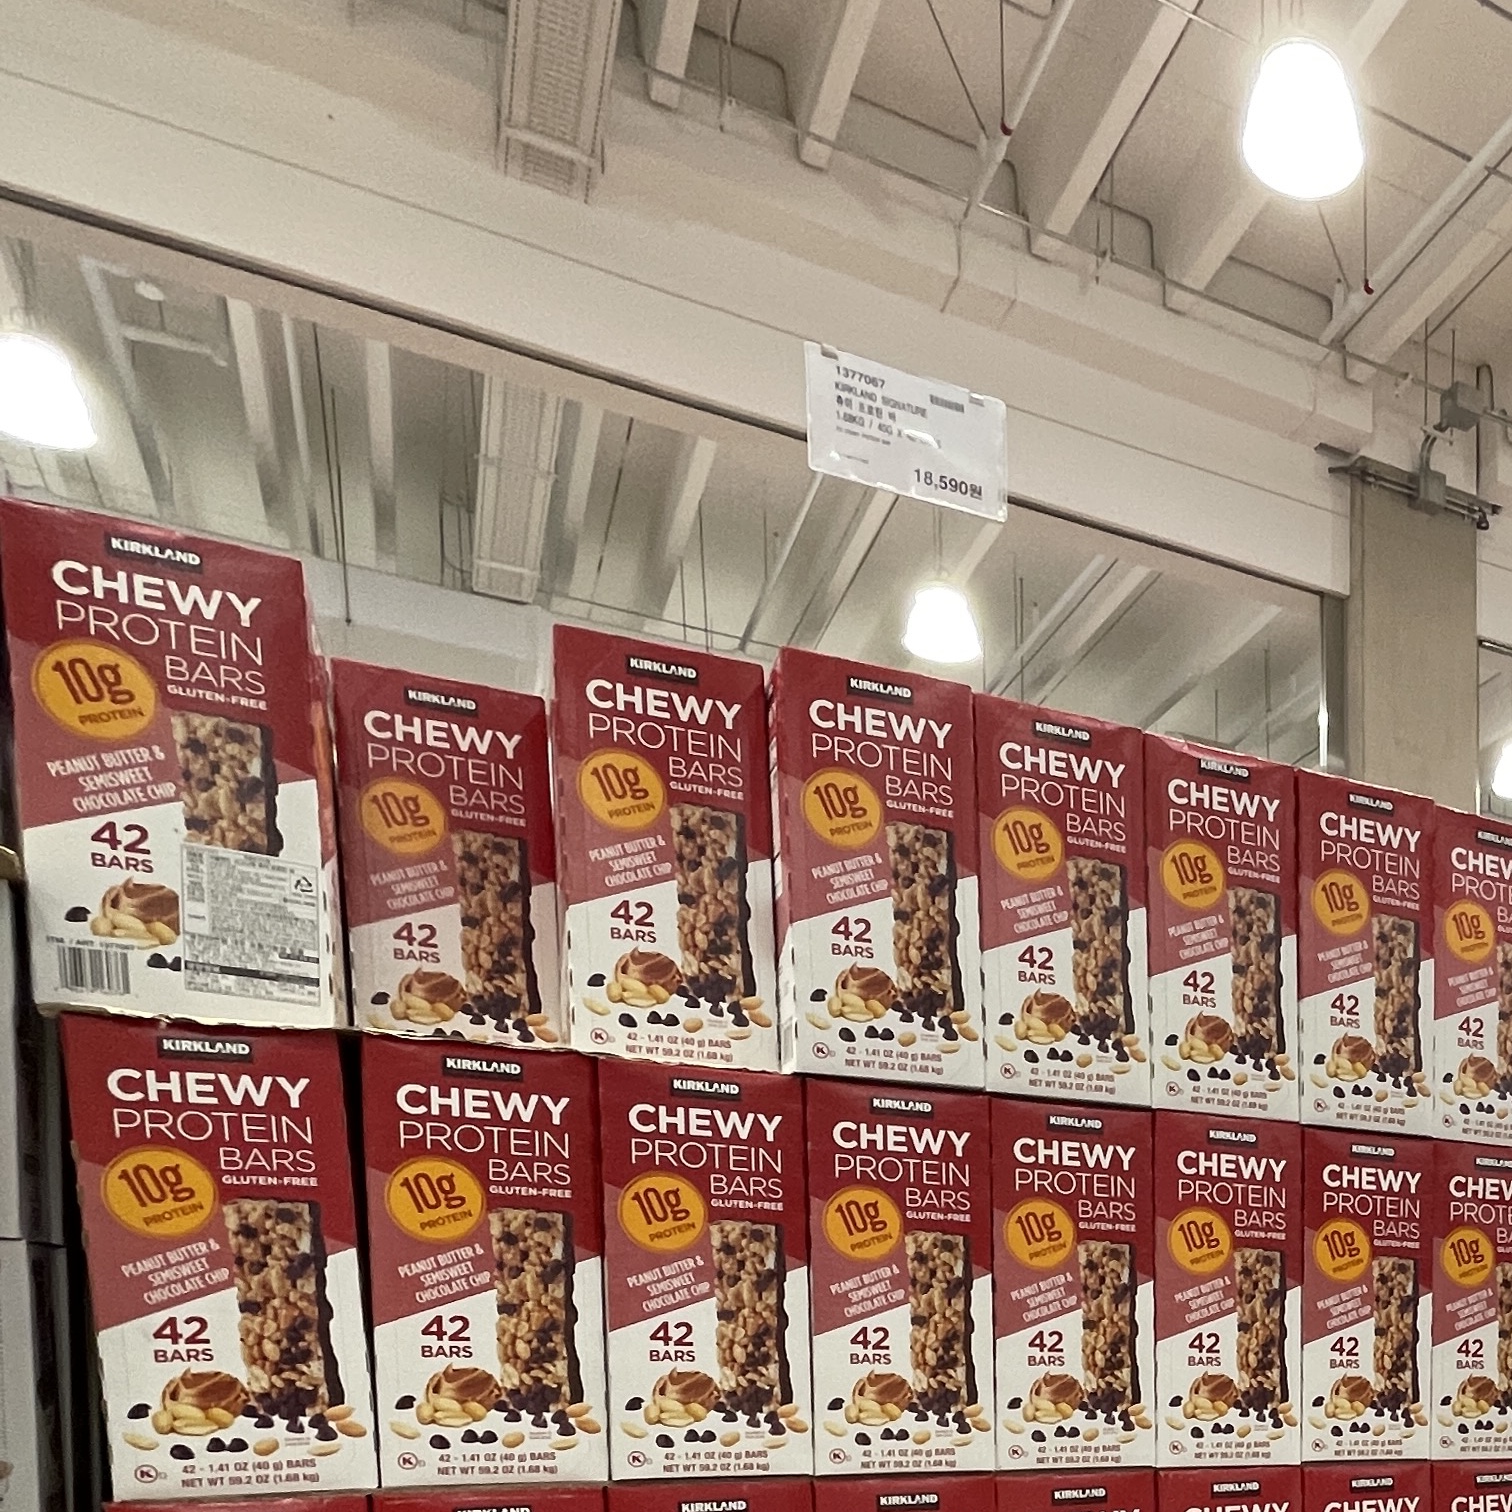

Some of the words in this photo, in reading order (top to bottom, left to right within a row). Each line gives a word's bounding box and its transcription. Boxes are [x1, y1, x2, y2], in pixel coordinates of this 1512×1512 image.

[835, 382, 877, 402] KIRKLAND
[881, 396, 928, 418] SIGNATURE
[914, 468, 983, 501] 18,590원
[110, 538, 200, 565] KIRKLAND
[51, 561, 262, 627] CHEWY
[56, 600, 264, 666] PROTEIN
[166, 656, 267, 695] BARS
[630, 658, 696, 677] KIRKLAND
[61, 662, 139, 705] 10g
[168, 685, 269, 710] GLUTEN-FREE
[84, 709, 148, 724] PROTEIN
[587, 679, 741, 729] CHEWY
[590, 713, 740, 762] PROTEIN
[592, 765, 648, 801] 10g
[669, 757, 742, 787] BARS
[91, 821, 151, 855] 42
[92, 853, 154, 874] BARS
[610, 900, 654, 927] 42
[1453, 913, 1485, 941] 10g
[611, 927, 656, 943] BARS
[1458, 1017, 1483, 1038] 42
[163, 1039, 249, 1054] KIRKLAND
[108, 1069, 309, 1107] CHEWY
[114, 1109, 312, 1144] PROTEIN
[220, 1147, 315, 1172] BARS
[120, 1164, 195, 1207] 10g
[222, 1175, 317, 1186] GLUTEN-FREE
[143, 1203, 204, 1226] PROTEIN
[121, 1254, 166, 1277] PEANUT
[167, 1242, 209, 1263] BUTTER
[209, 1239, 220, 1250] &
[148, 1258, 209, 1286] SEMISWEET
[144, 1276, 205, 1304] CHOCOLATE
[205, 1268, 229, 1284] CHIP
[153, 1317, 210, 1344] 42
[154, 1349, 213, 1362] BARS
[1056, 1488, 1106, 1498] KIRKLAND
